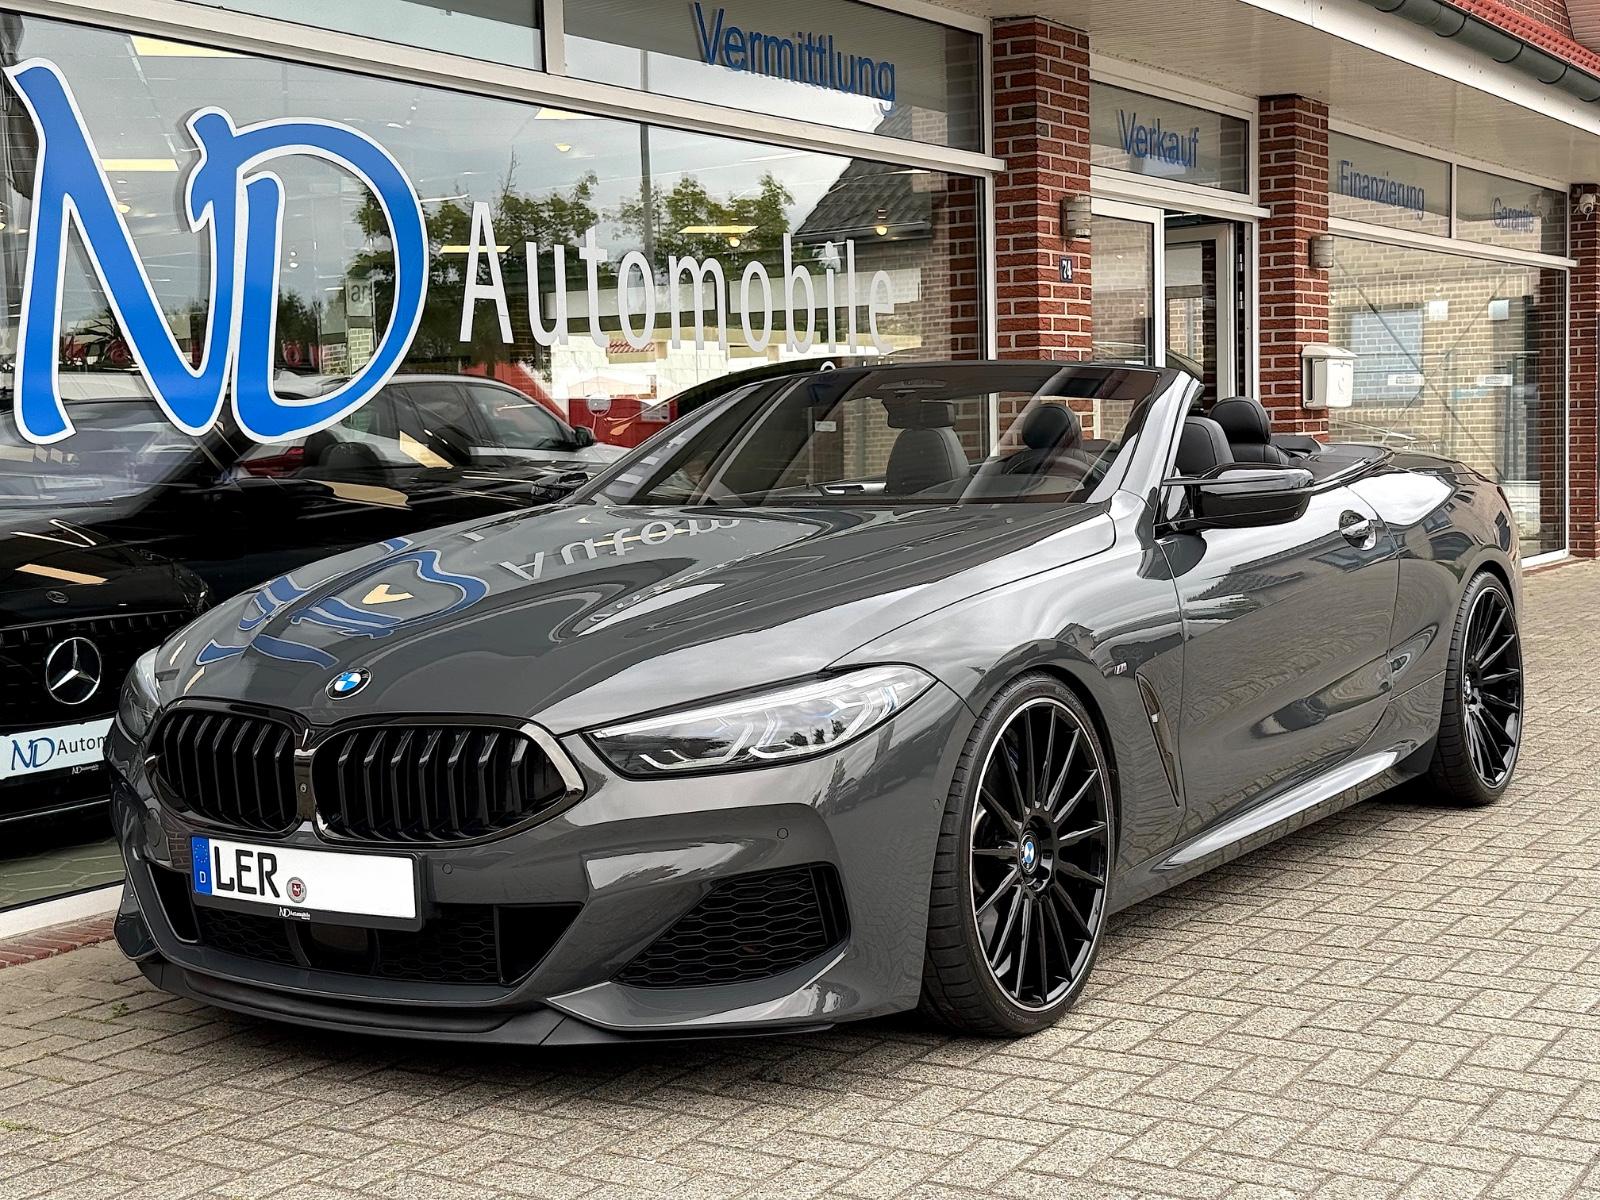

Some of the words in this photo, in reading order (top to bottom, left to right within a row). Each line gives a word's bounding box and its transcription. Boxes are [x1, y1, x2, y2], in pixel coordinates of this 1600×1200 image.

[694, 2, 896, 118] Vermittlung
[1120, 109, 1200, 169] Verkauf
[1340, 160, 1425, 221] Finanzierung
[3, 57, 428, 445] ND
[459, 201, 896, 354] Automobile
[1061, 259, 1072, 280] 74
[11, 737, 55, 770] ND
[199, 870, 207, 884] D
[213, 846, 280, 898] LER
